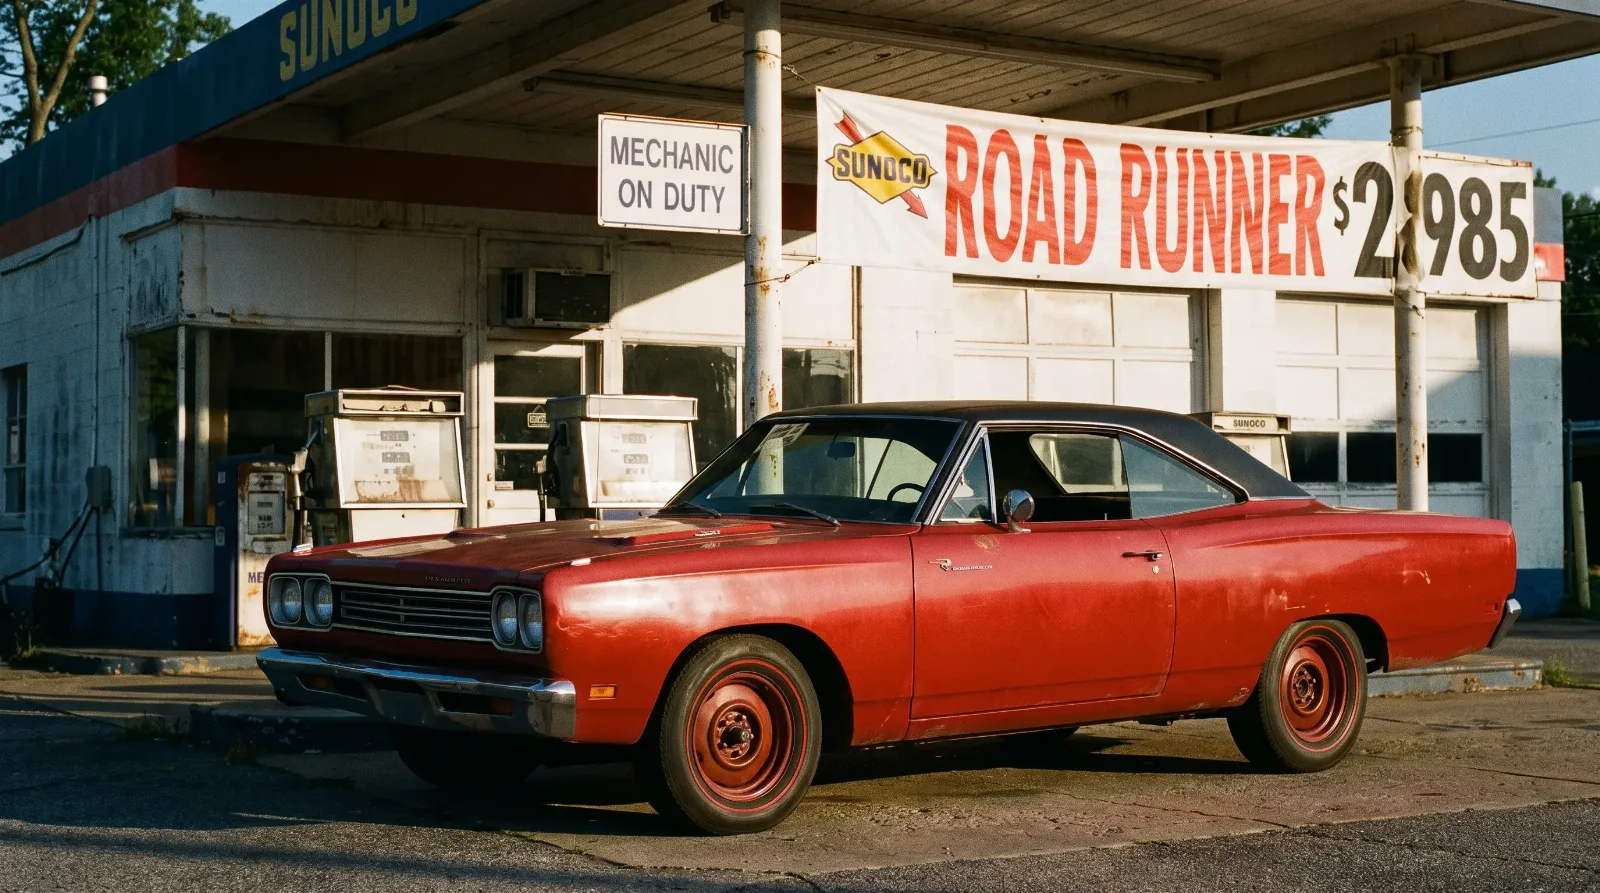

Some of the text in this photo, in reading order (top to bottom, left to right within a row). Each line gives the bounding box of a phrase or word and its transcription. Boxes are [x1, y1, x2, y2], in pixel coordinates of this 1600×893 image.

[610, 135, 734, 175] MECHANIC
[836, 148, 927, 185] SUNOCO
[618, 178, 726, 214] ON DUTY
[944, 123, 1099, 266] ROAD
[1119, 142, 1326, 277] RUNNER
[1233, 419, 1266, 428] SUNOCO
